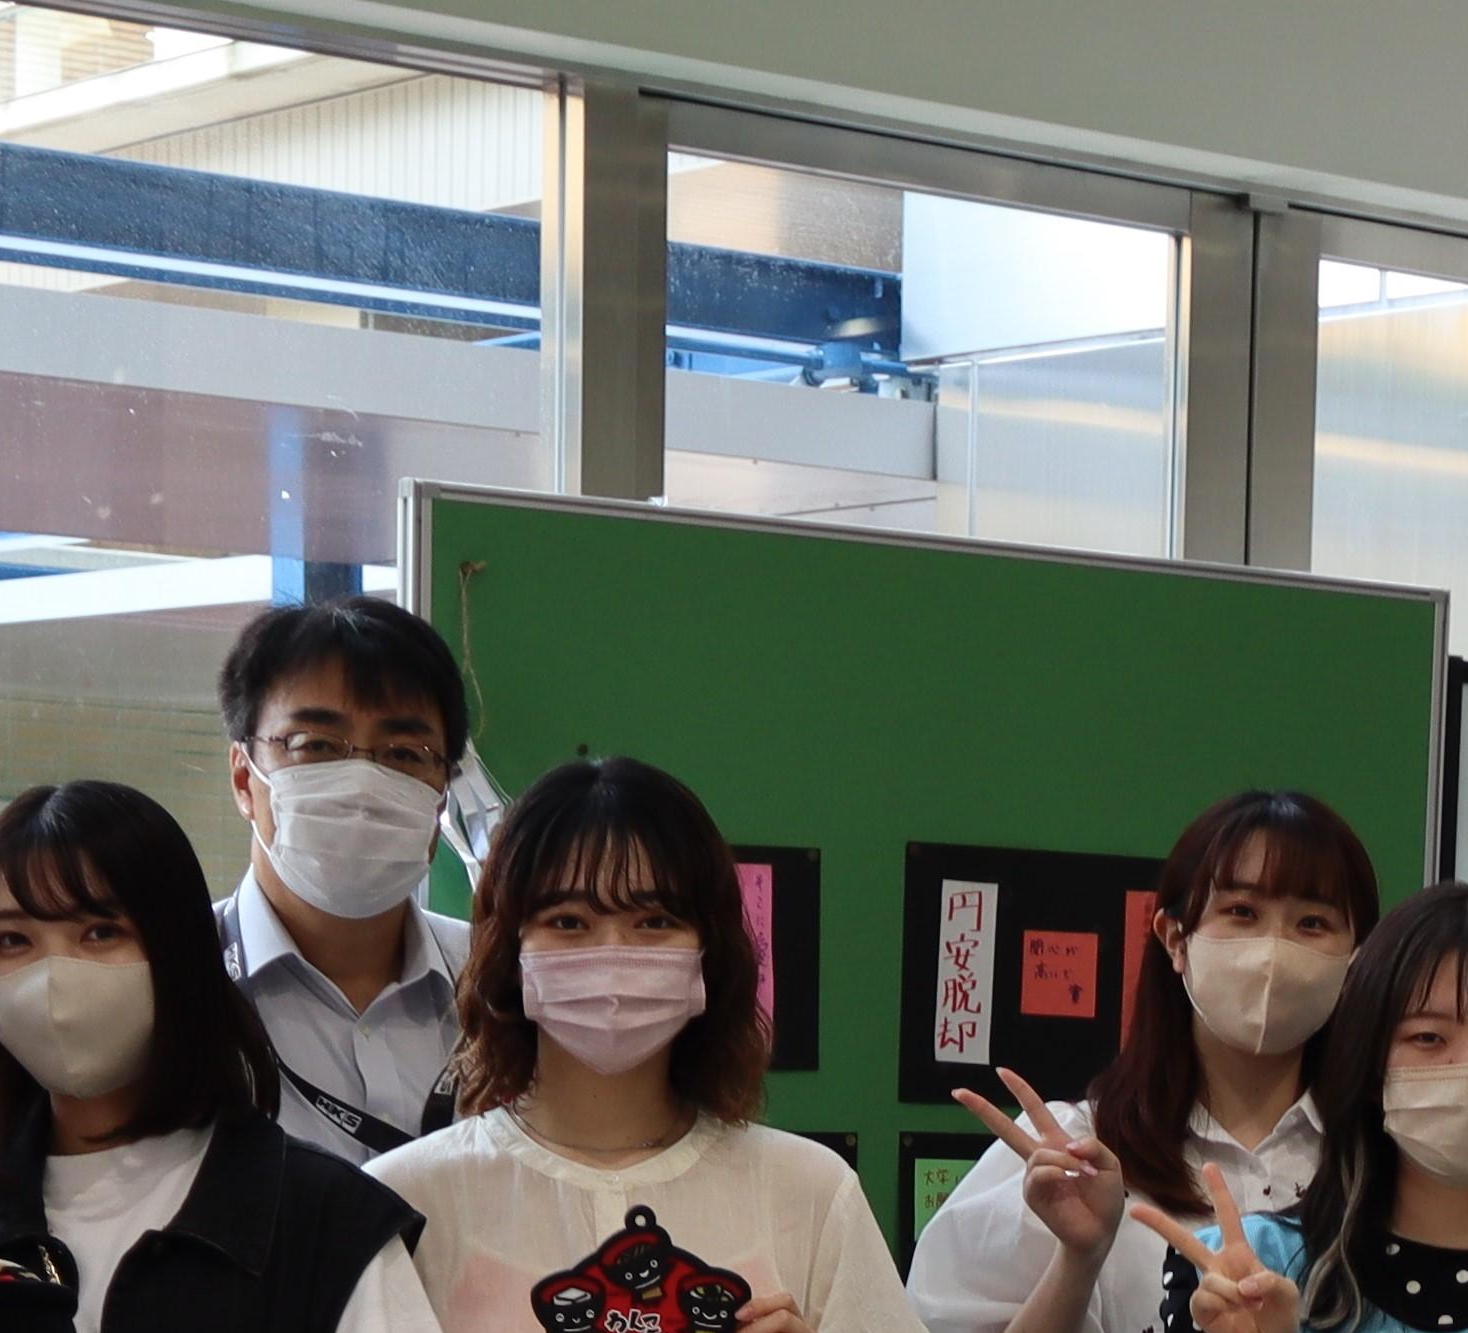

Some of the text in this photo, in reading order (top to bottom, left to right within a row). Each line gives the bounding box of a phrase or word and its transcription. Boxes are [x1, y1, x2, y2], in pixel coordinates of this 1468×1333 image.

[937, 888, 983, 1055] 円安脱却
[316, 1096, 362, 1132] HKS
